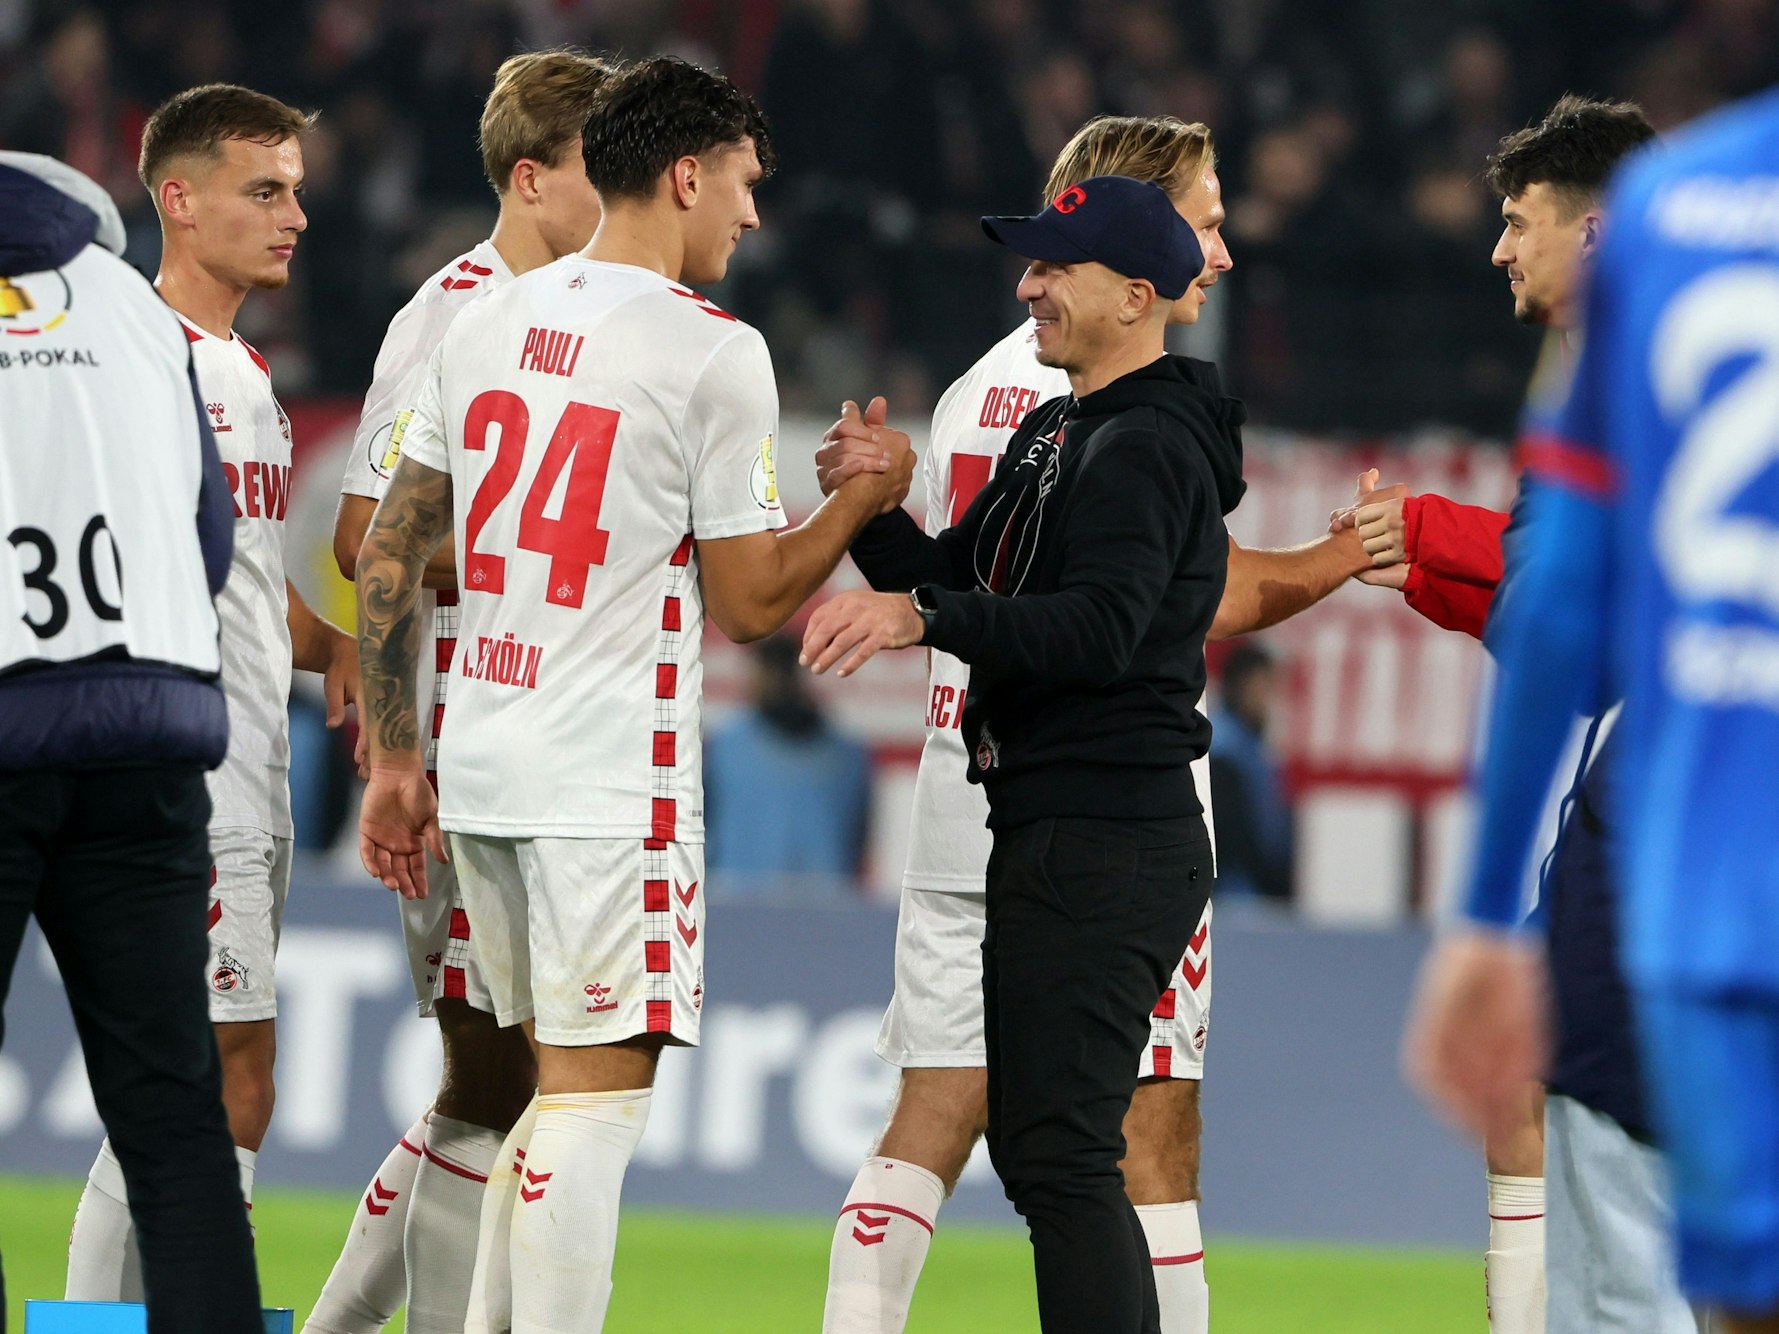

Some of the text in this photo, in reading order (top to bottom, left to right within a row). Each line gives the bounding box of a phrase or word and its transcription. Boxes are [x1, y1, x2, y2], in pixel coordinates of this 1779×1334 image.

[1052, 184, 1087, 214] C
[519, 327, 585, 377] PAULI
[221, 461, 293, 521] REW
[463, 389, 621, 609] 24
[7, 513, 124, 640] 30
